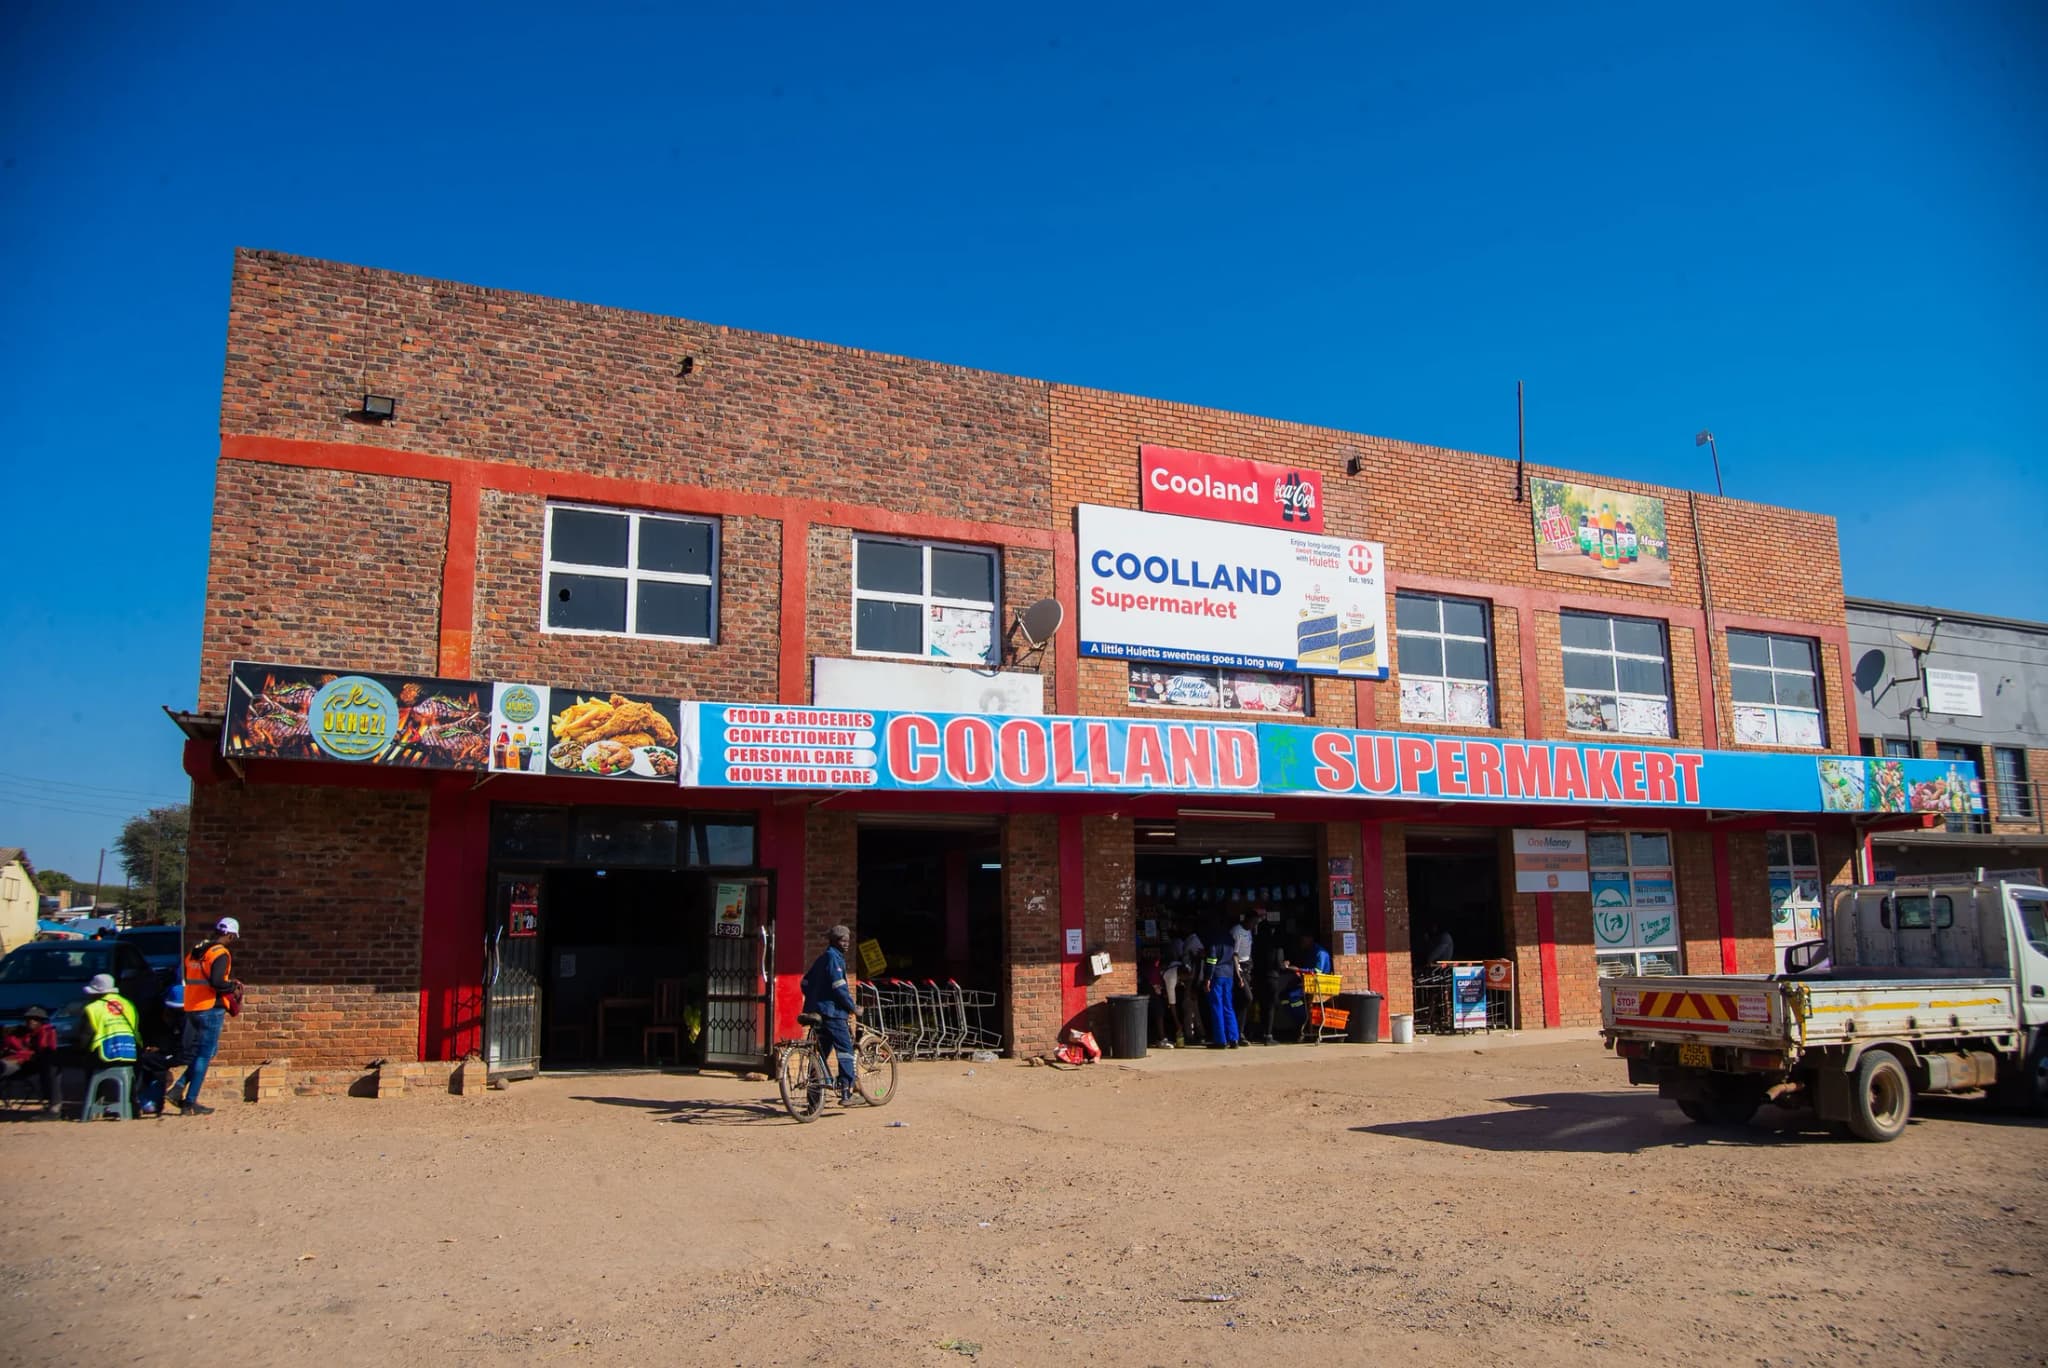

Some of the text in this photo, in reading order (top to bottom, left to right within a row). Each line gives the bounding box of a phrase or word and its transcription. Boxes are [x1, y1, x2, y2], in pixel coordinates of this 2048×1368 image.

[1151, 468, 1259, 504] Cooland
[1541, 516, 1575, 542] REAL
[1290, 538, 1306, 547] Enjoy
[1309, 555, 1340, 568] Huletts
[1313, 549, 1341, 558] memories
[1091, 549, 1281, 596] COOLLAND
[1091, 586, 1237, 620] Supermarket
[1090, 644, 1284, 670] A little Huletts sweetness goes a long way
[323, 711, 386, 735] UKHOZI
[729, 709, 770, 724] FOOD
[729, 728, 857, 746] CONFECTIONERY
[729, 748, 854, 765] PERSONAL CARE
[887, 716, 1702, 803] COOLLAND SUPERMAKERT
[730, 768, 871, 784] HOUSE HOLD CARE
[1616, 998, 1636, 1007] STOP
[1684, 1054, 1706, 1066] 5958
